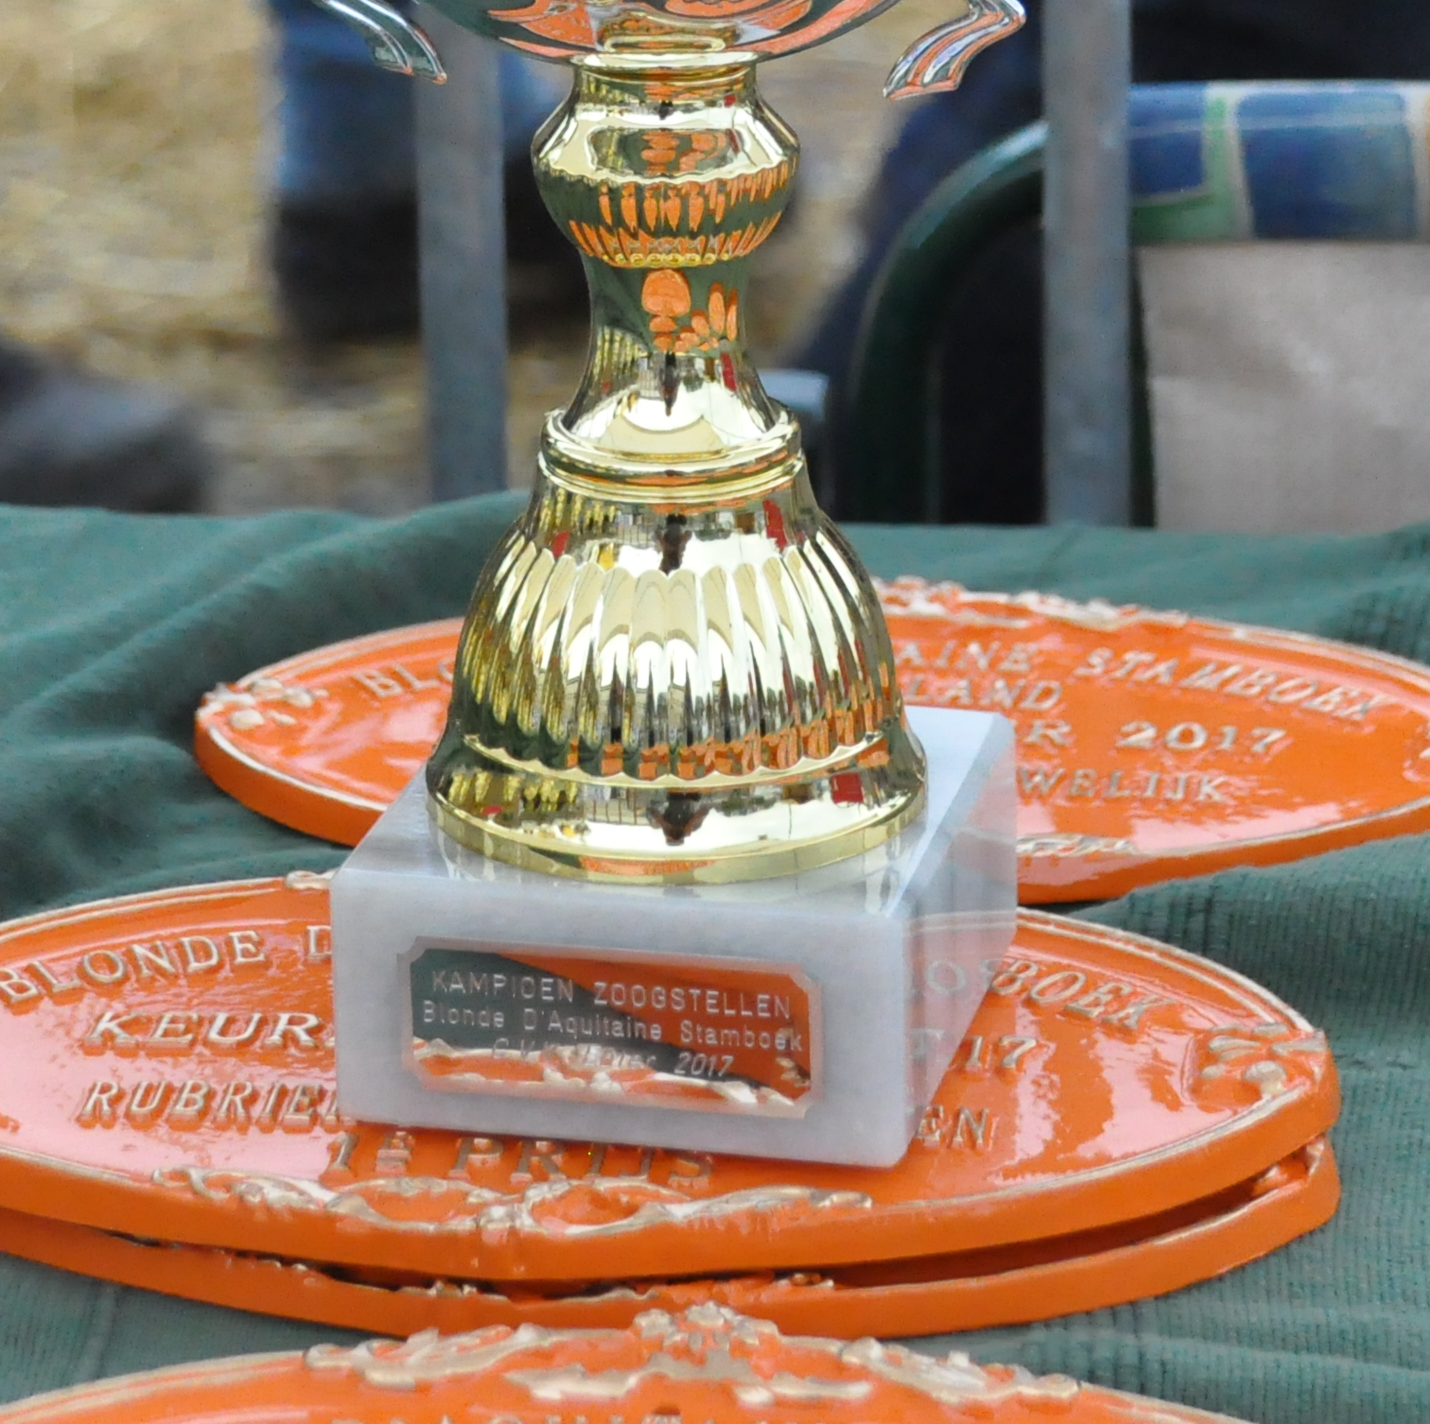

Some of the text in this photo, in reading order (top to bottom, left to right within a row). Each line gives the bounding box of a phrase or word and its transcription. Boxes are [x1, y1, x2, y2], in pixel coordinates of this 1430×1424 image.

[1074, 648, 1393, 722] STAMBOEK
[1117, 720, 1287, 754] 2017
[432, 970, 790, 1020] KAMPIOEN ZOOGSTELLEN
[423, 999, 803, 1051] Blonde D'Aquitaine Stamboek
[674, 1051, 735, 1078] 2017
